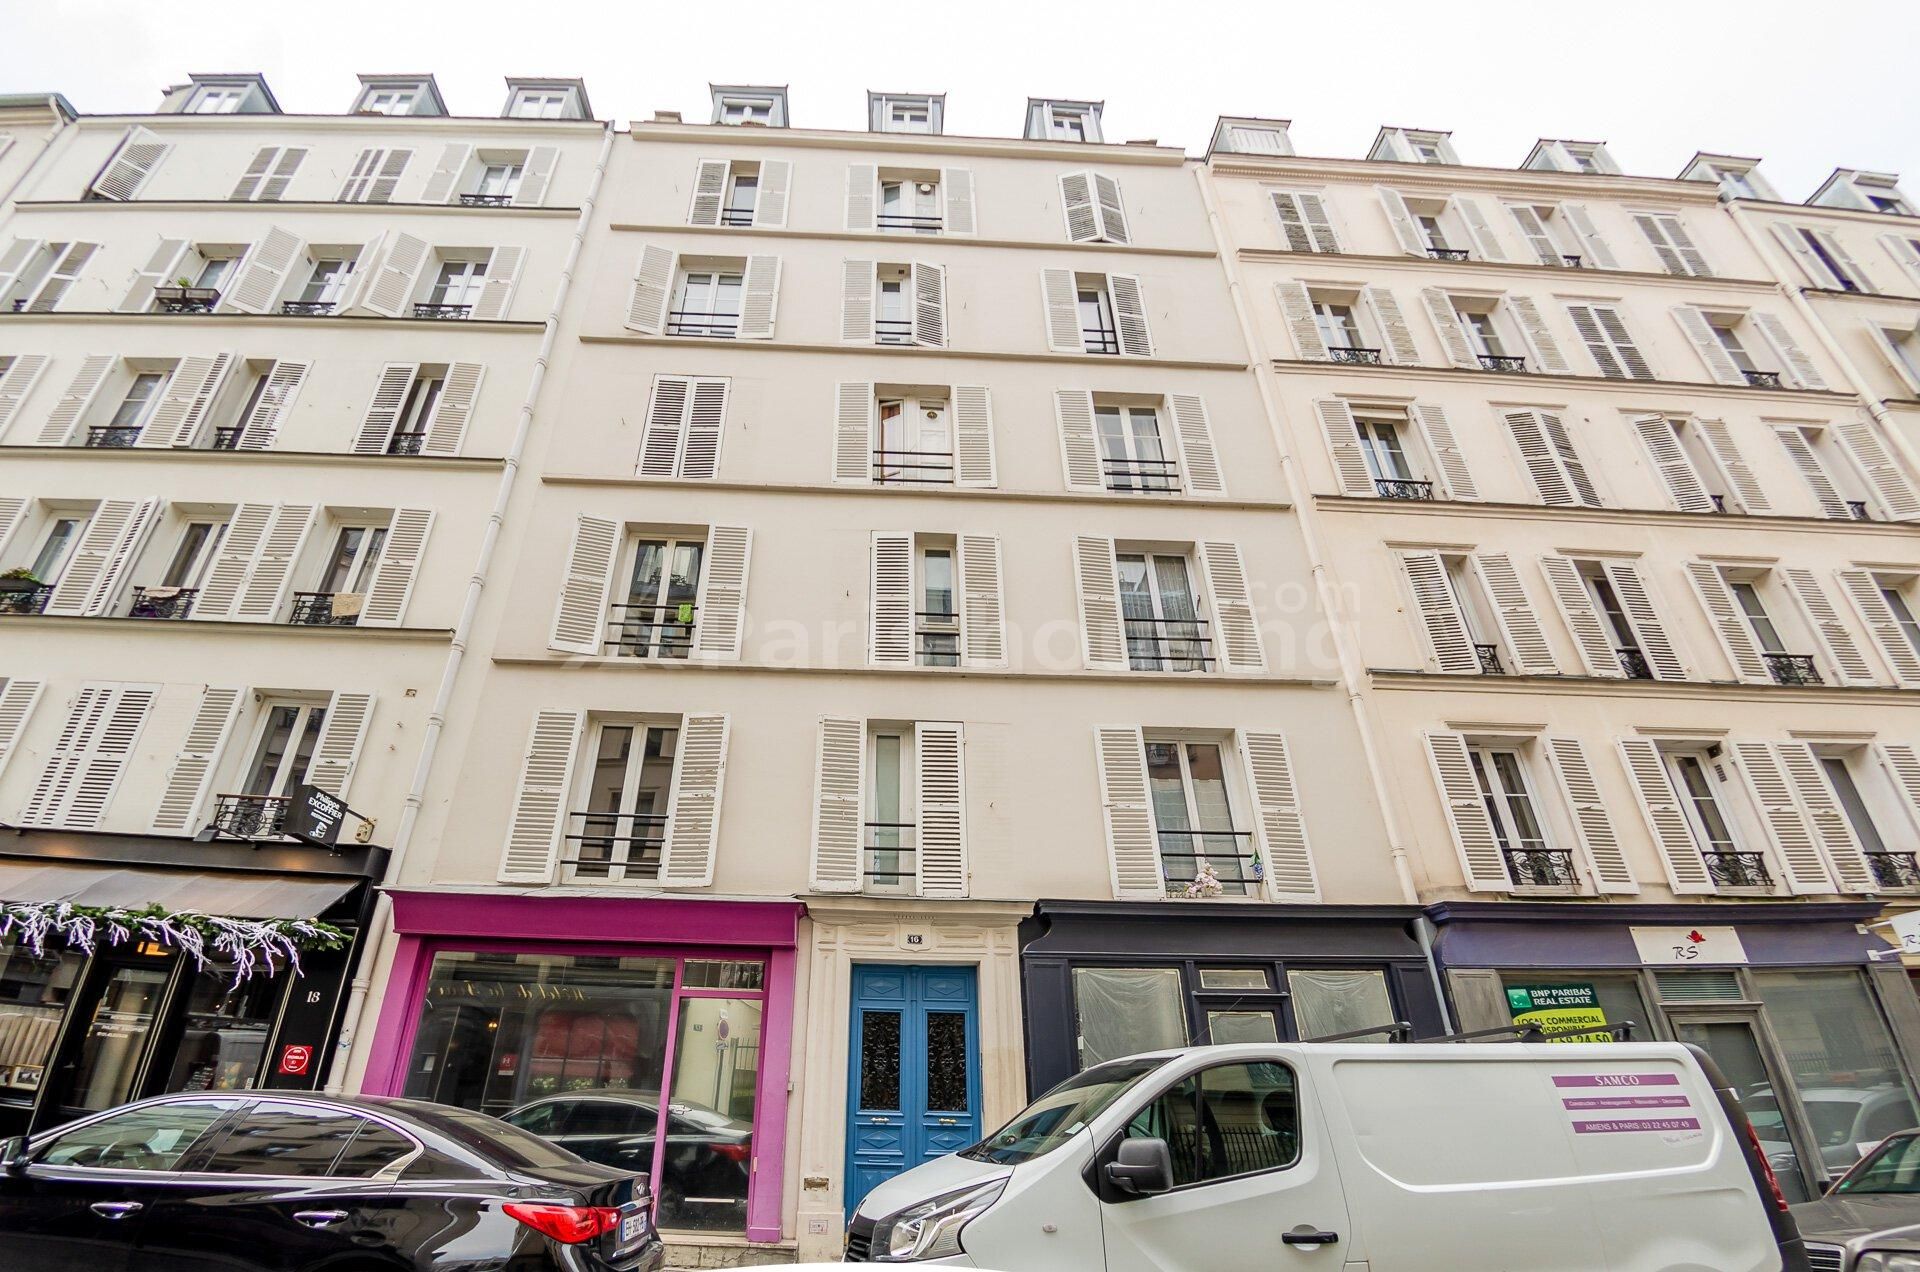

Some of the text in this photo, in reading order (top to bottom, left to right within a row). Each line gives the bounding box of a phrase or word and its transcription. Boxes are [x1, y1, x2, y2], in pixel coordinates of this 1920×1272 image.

[315, 792, 340, 810] Philippe
[308, 797, 343, 820] EXCOFFIER
[1672, 945, 1699, 960] RS
[306, 990, 321, 1003] 18
[1530, 988, 1592, 998] BNP PARIBAS
[1533, 996, 1592, 1006] REAL ESTATE
[1546, 1015, 1601, 1025] COMMERCIAL
[1594, 1075, 1640, 1087] SAMCO
[1585, 1123, 1611, 1131] AMIENS
